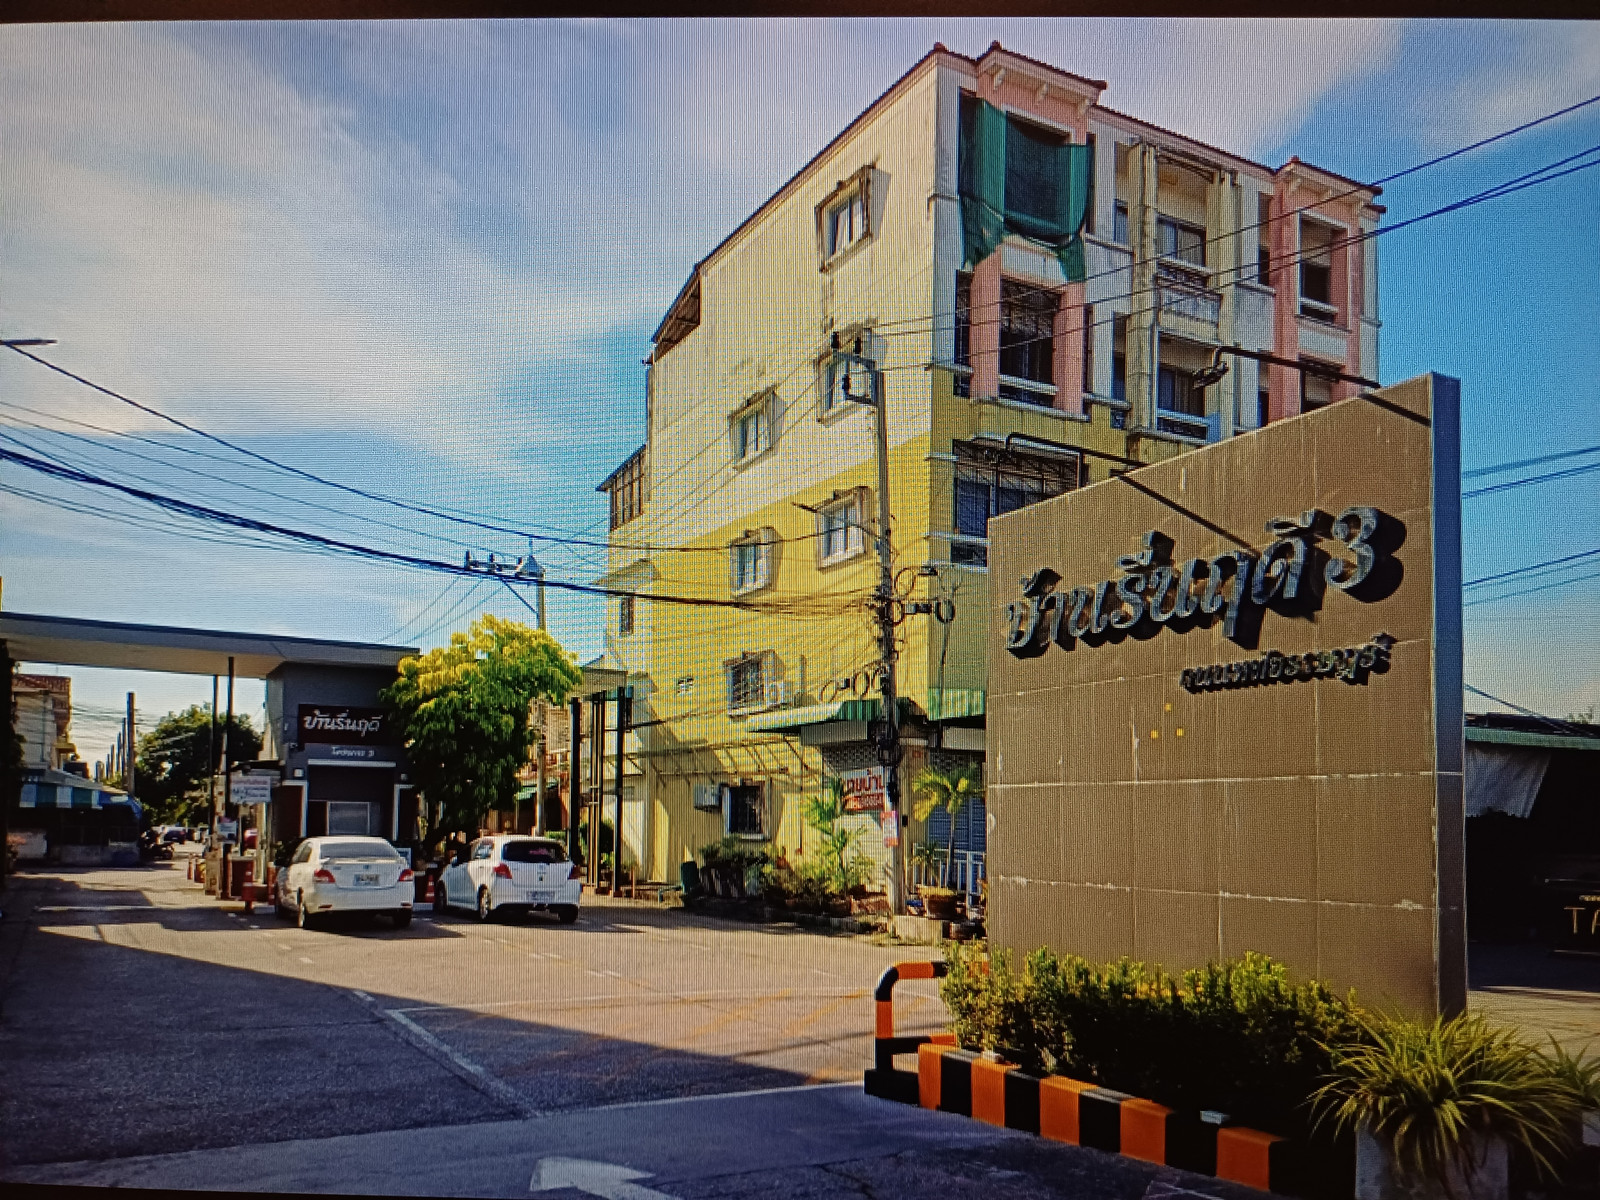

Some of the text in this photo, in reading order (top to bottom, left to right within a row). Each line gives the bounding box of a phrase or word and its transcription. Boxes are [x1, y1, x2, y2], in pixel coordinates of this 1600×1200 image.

[1007, 506, 1380, 650] บ้านรื่นฤดี 3
[303, 709, 383, 737] บ้านรื่นฤดี
